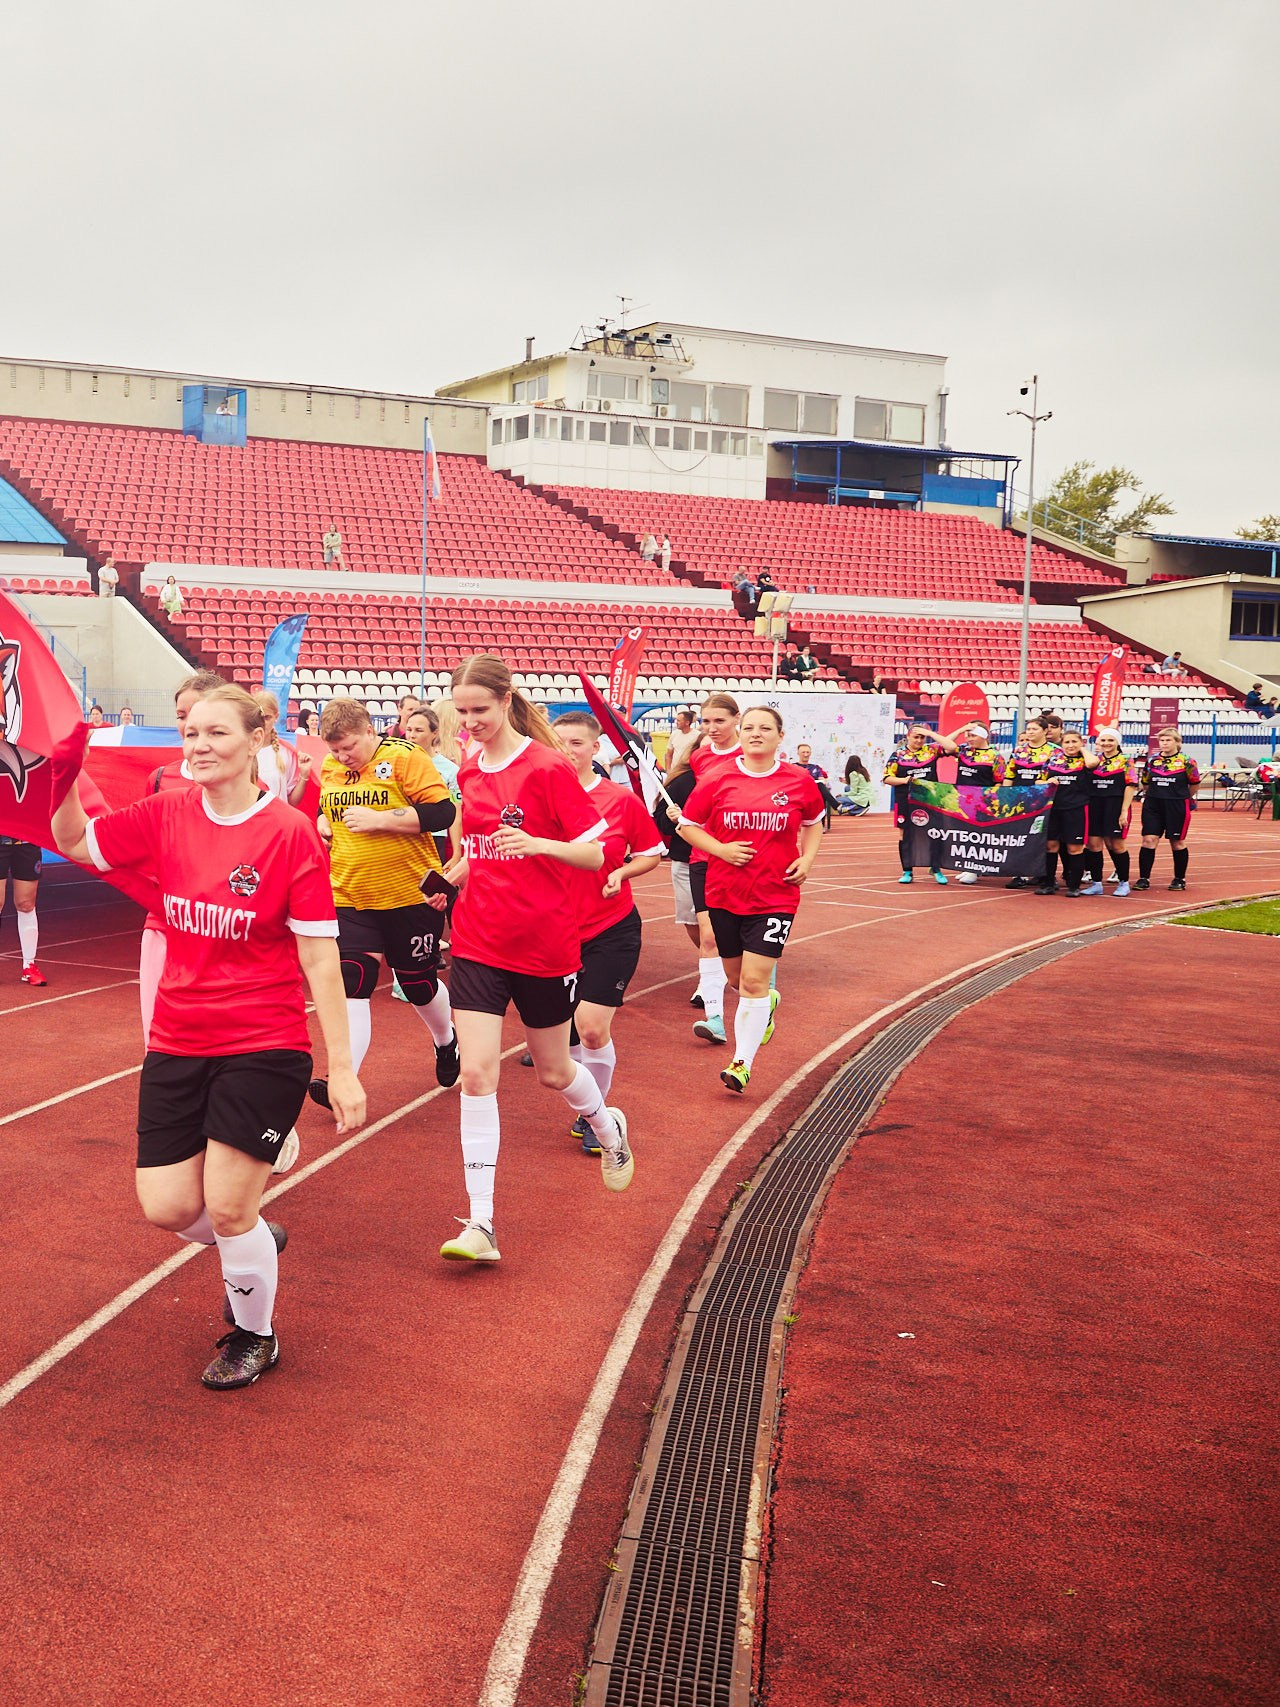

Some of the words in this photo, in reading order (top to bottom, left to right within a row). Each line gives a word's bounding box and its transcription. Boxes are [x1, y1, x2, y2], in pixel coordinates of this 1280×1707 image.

[1096, 672, 1113, 717] ОСНОВА
[344, 770, 361, 785] 20
[723, 811, 790, 831] МЕТАЛЛИСТ
[927, 827, 1028, 847] ФУТБОЛЬНЫЕ
[950, 844, 1008, 864] МАМЫ
[954, 860, 963, 868] г.
[964, 861, 1000, 873] Шахунья
[163, 893, 256, 941] МЕТАЛЛИСТ
[762, 917, 792, 945] 23
[410, 933, 434, 958] 20
